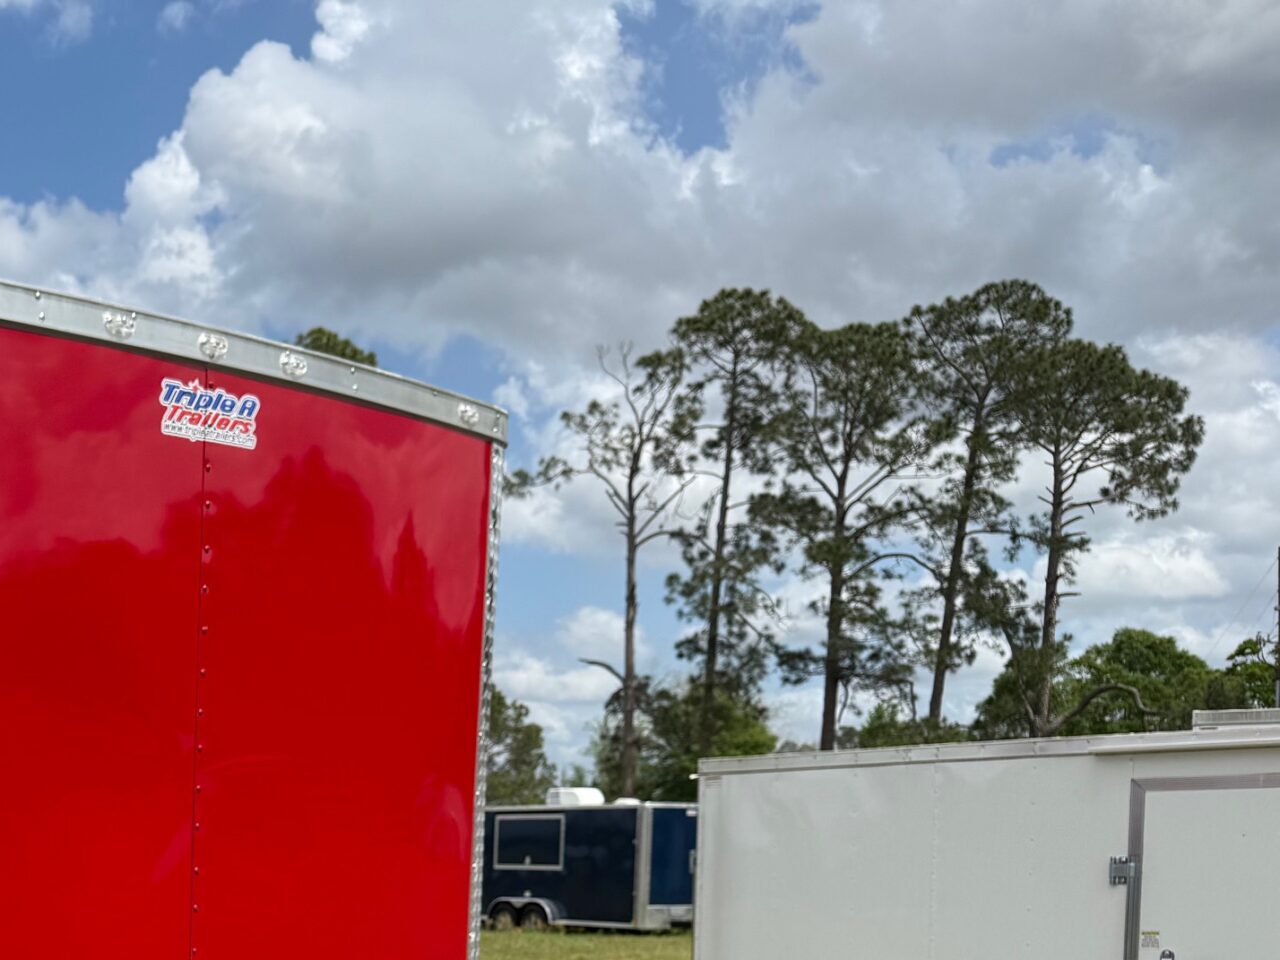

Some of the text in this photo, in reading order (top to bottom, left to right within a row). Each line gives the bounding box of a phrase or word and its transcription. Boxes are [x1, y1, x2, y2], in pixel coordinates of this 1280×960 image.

[163, 384, 257, 417] Triple A
[167, 405, 252, 434] Trailers
